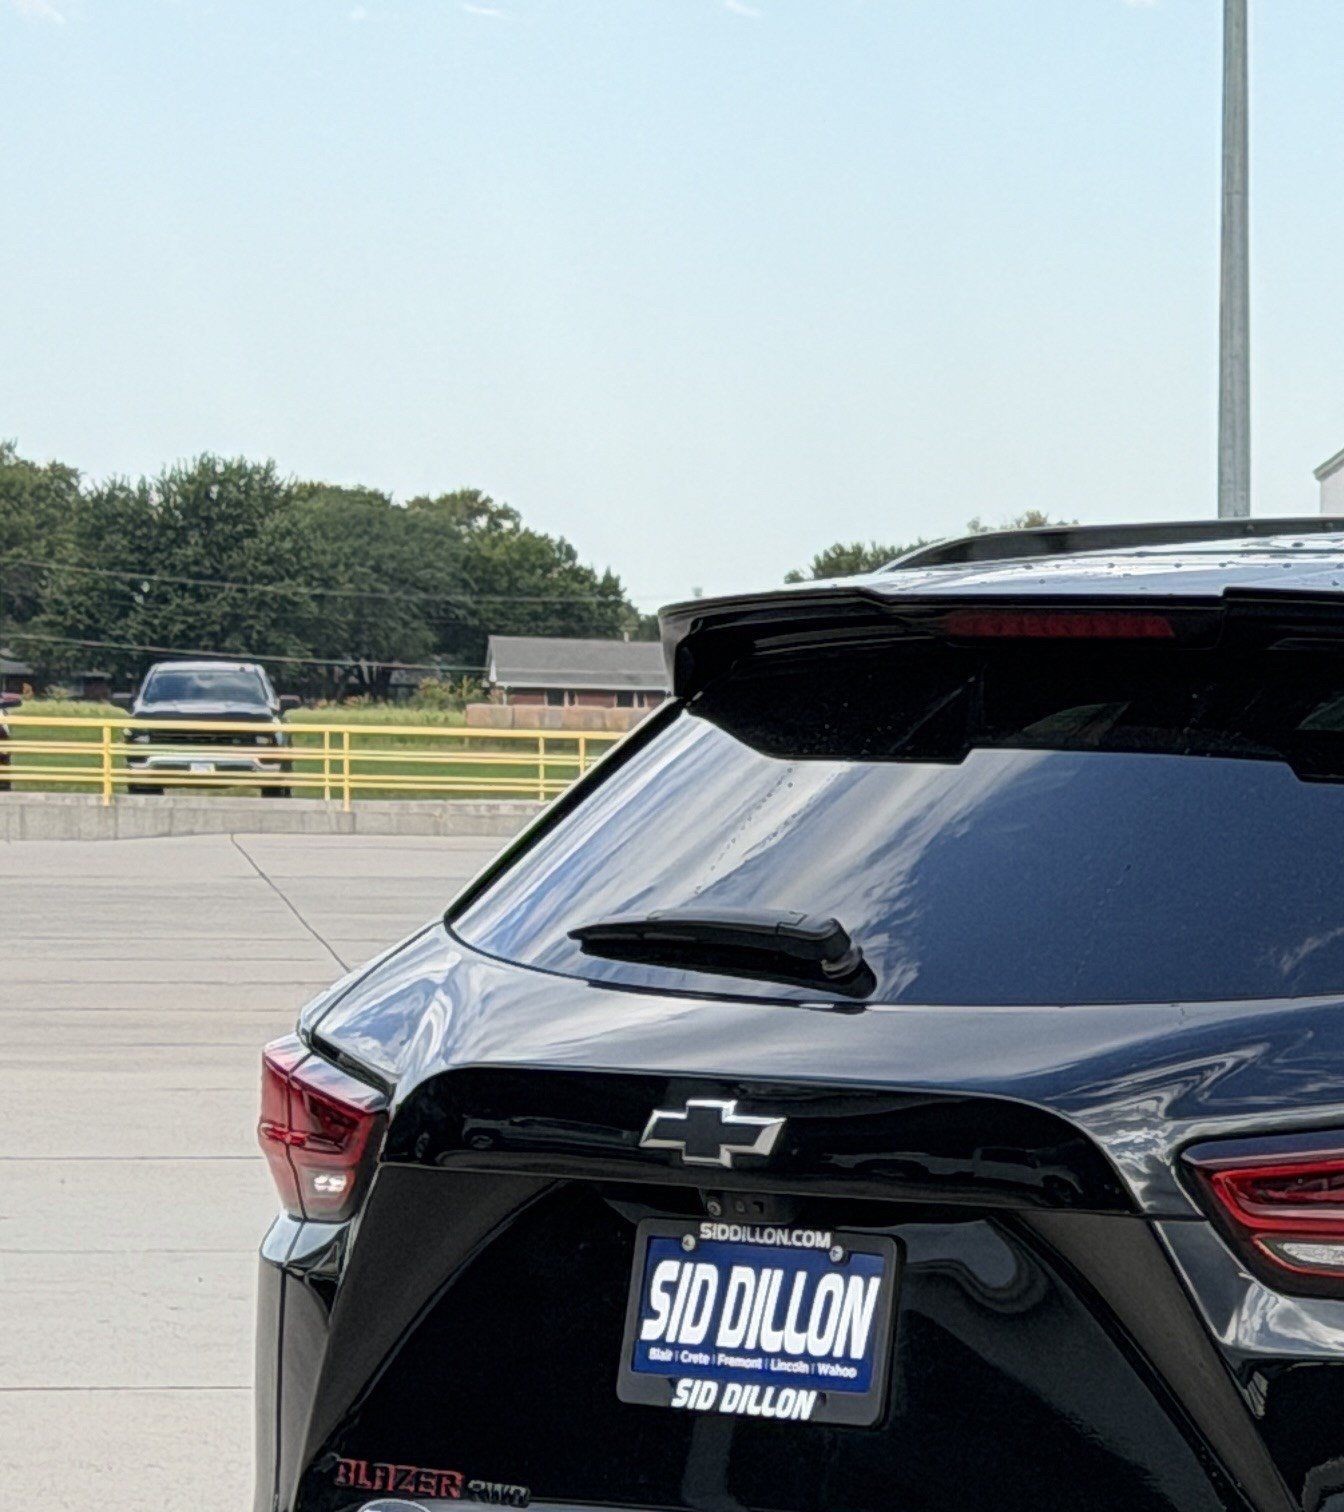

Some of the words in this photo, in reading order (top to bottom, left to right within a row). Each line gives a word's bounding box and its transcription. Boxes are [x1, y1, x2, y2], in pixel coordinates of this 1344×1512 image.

[700, 1222, 831, 1249] SIDDILLON.COM
[640, 1260, 718, 1345] SID
[716, 1266, 881, 1360] DILLON
[680, 1350, 711, 1367] Crete
[717, 1354, 763, 1370] Fremont
[770, 1358, 810, 1375] Lincoln
[671, 1378, 718, 1411] SID
[718, 1383, 817, 1420] DILLON
